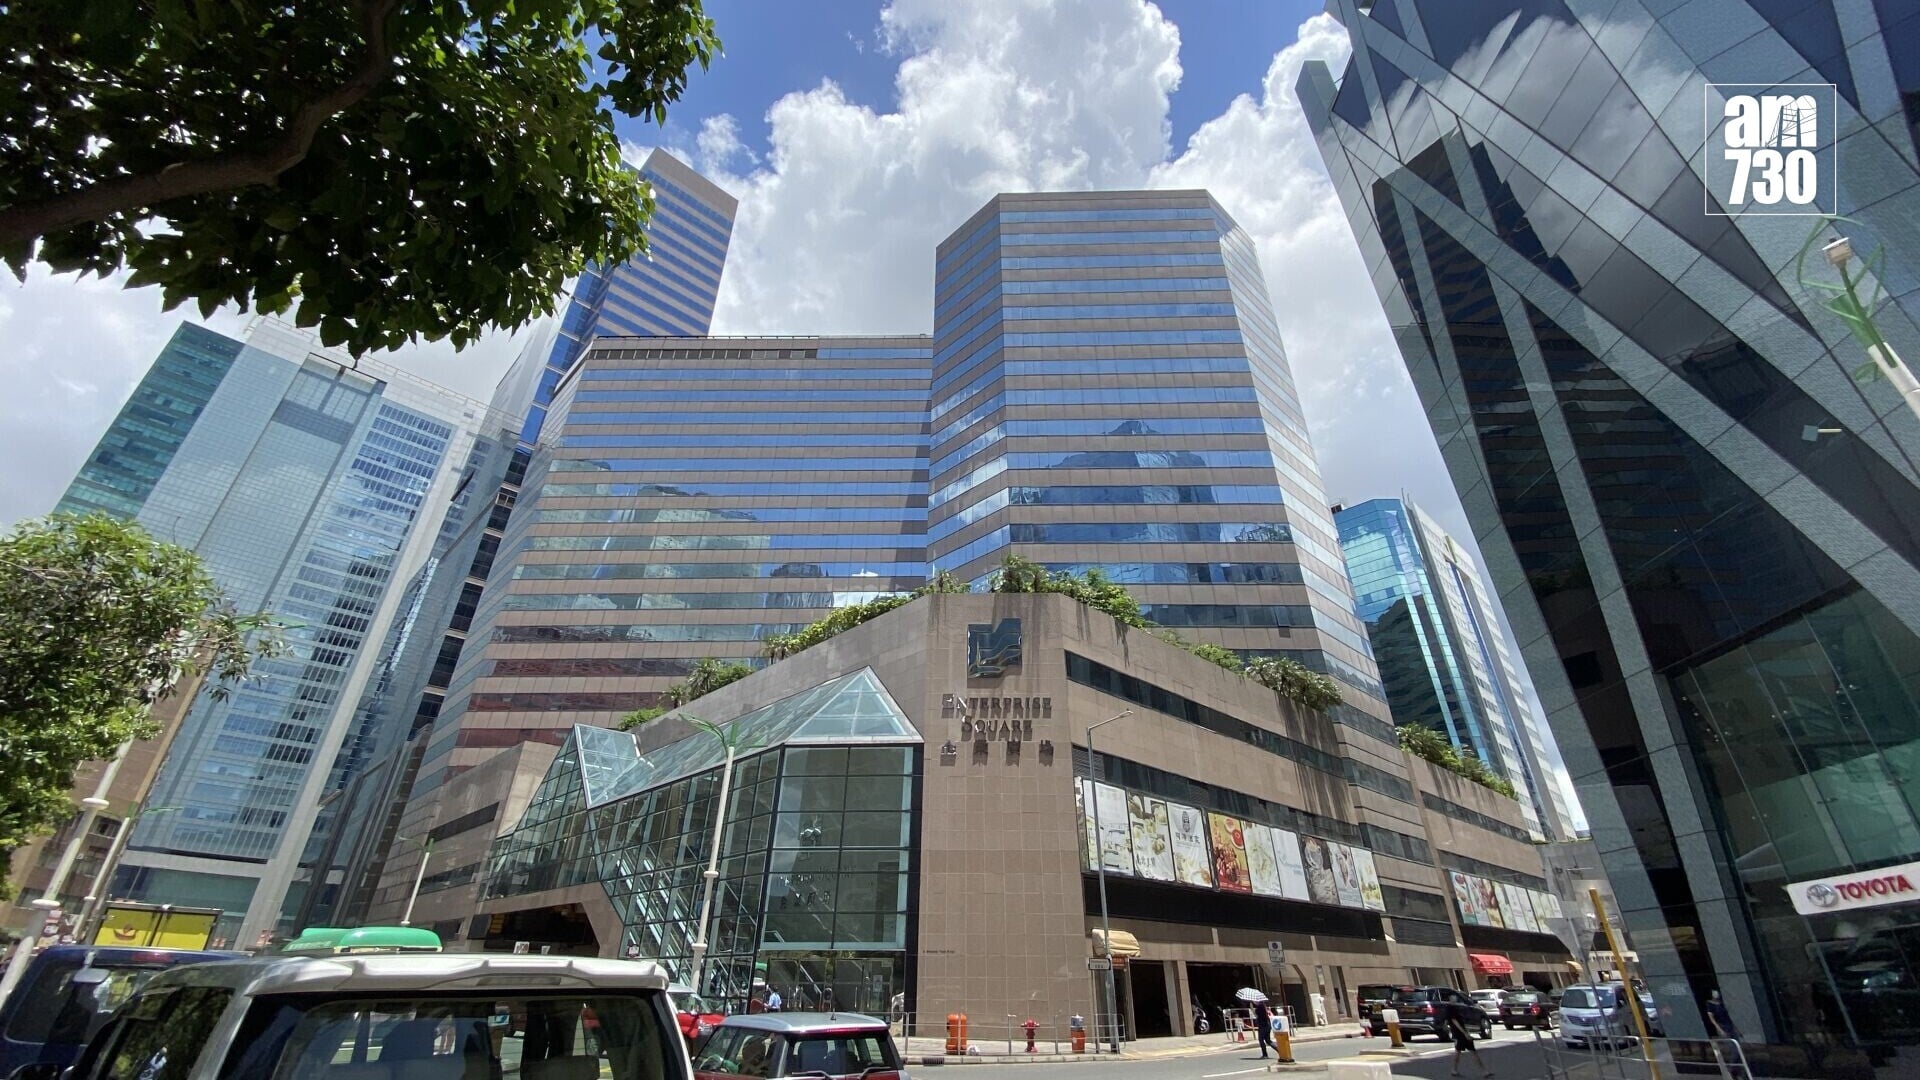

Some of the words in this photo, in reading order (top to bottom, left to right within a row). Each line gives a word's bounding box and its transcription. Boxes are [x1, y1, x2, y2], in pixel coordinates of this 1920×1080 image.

[942, 694, 1052, 711] ENTERPRISE
[961, 716, 1033, 733] SQUARE
[1834, 874, 1914, 901] TOYOTA
